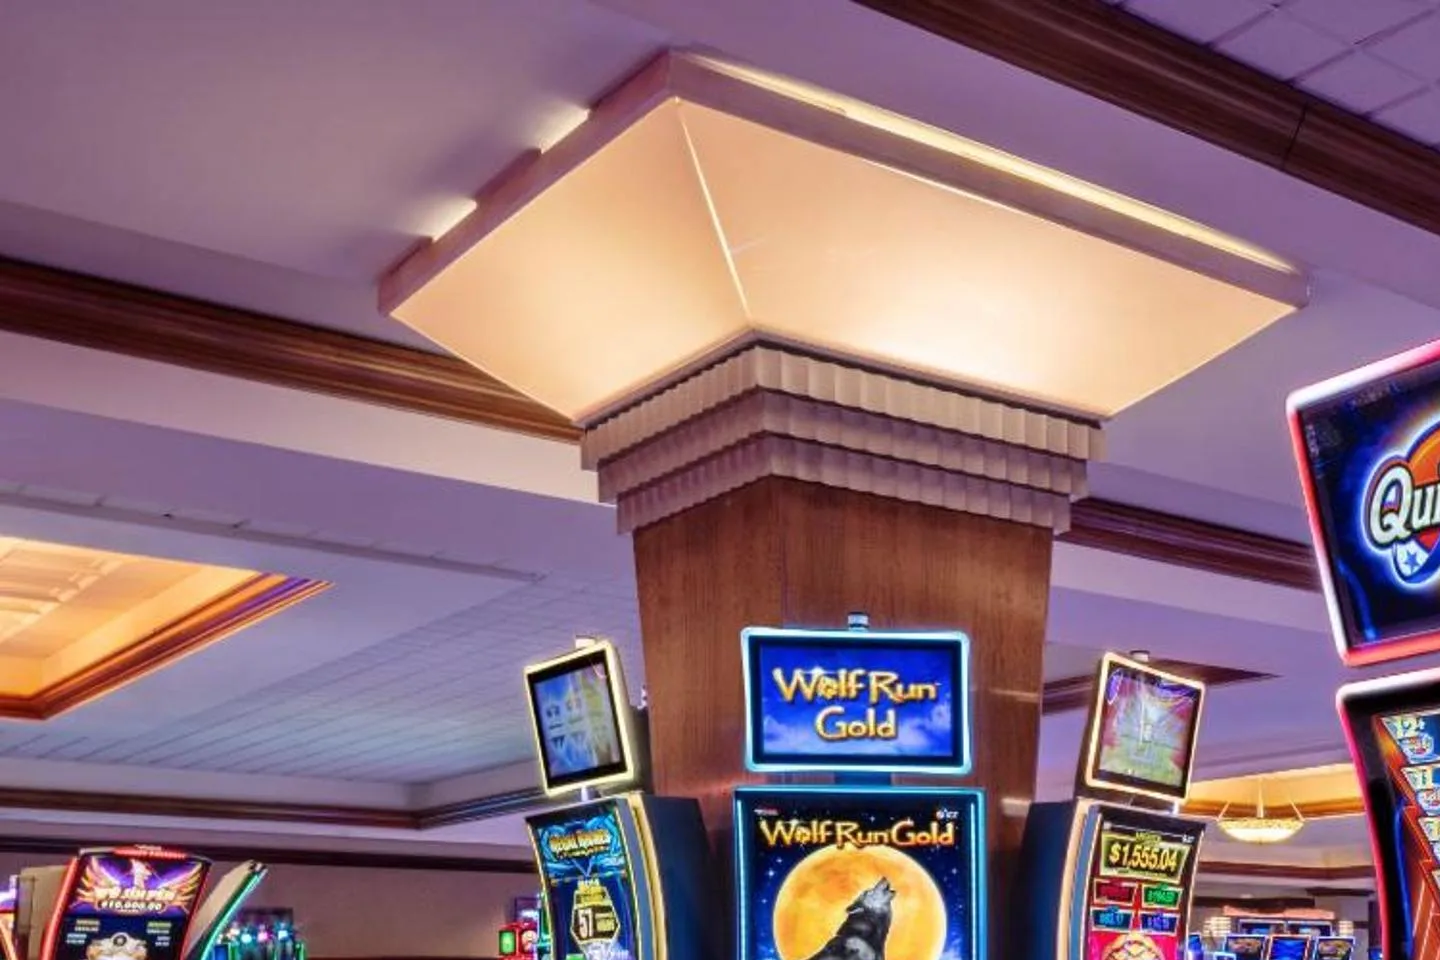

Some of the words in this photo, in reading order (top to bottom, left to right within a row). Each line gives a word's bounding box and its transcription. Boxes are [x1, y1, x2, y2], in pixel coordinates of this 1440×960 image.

[772, 666, 867, 702] Wolf
[868, 670, 938, 704] Run
[815, 705, 897, 741] Gold
[759, 818, 833, 847] Wolf
[833, 820, 890, 850] Run
[889, 818, 956, 847] Gold
